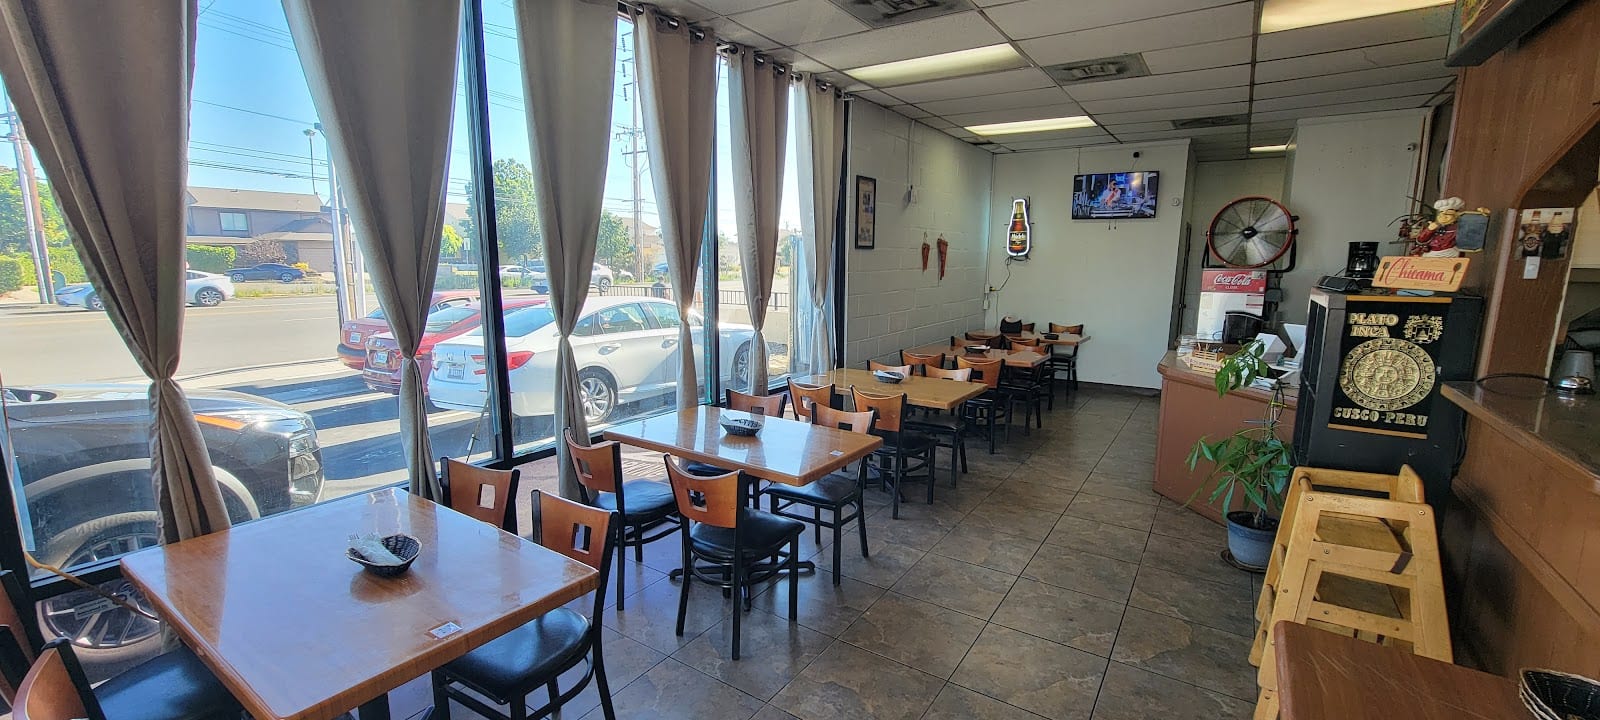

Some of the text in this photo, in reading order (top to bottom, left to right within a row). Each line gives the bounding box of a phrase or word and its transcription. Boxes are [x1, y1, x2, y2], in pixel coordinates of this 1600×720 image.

[1385, 258, 1445, 285] Chicama
[1349, 313, 1399, 326] PLATO
[1350, 325, 1390, 338] INCA
